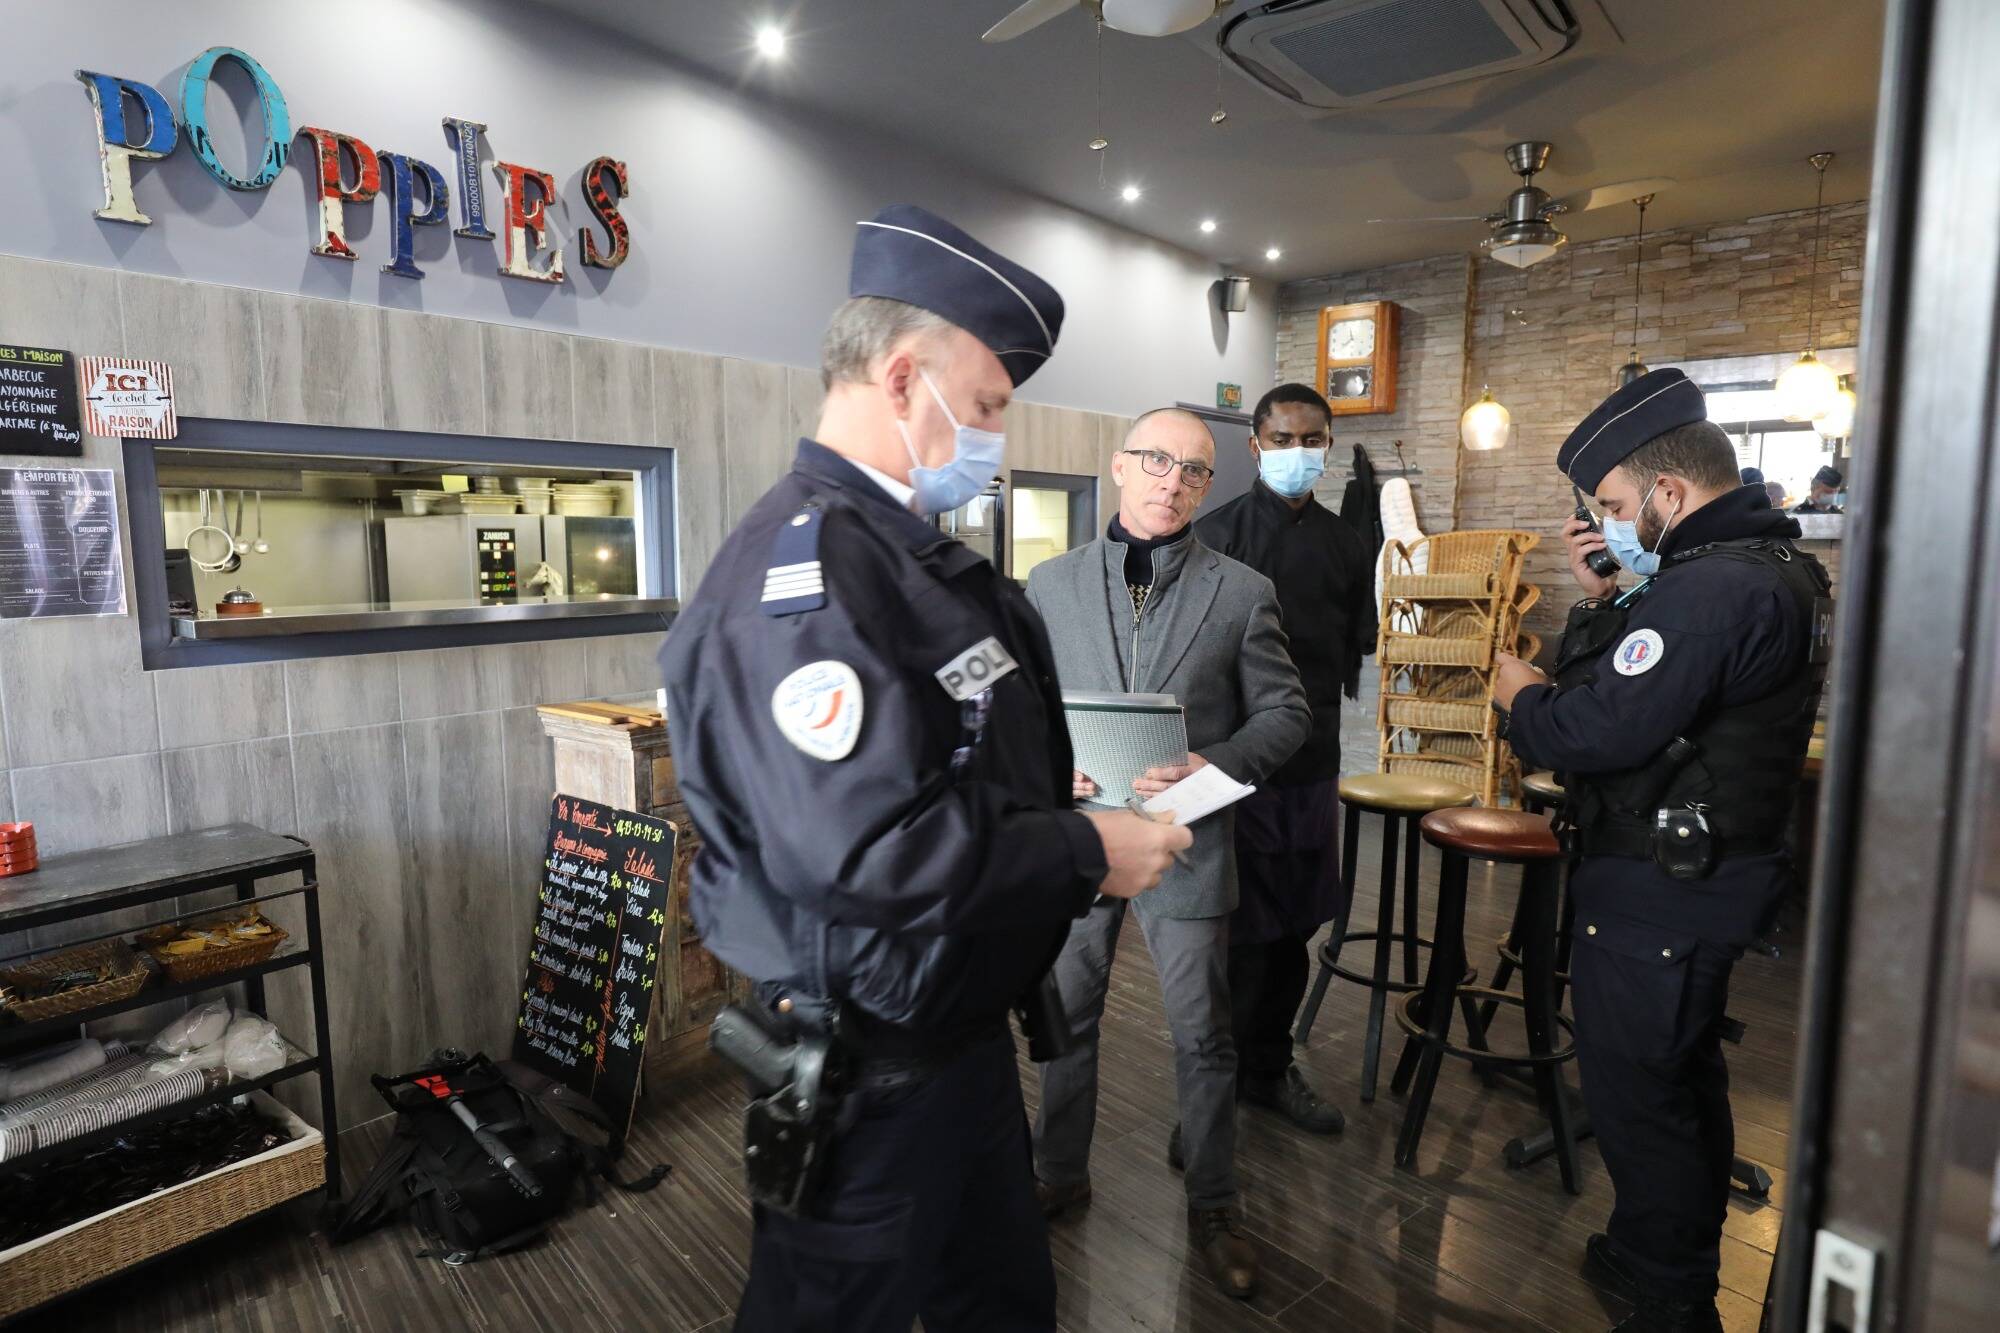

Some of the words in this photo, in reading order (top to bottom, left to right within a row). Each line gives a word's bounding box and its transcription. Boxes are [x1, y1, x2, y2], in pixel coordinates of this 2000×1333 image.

[75, 46, 631, 285] POPPIES
[23, 350, 64, 363] MAISON
[105, 373, 147, 391] ICI
[125, 392, 148, 404] chef
[109, 415, 153, 429] RAISON
[483, 531, 510, 541] ZANUSSI
